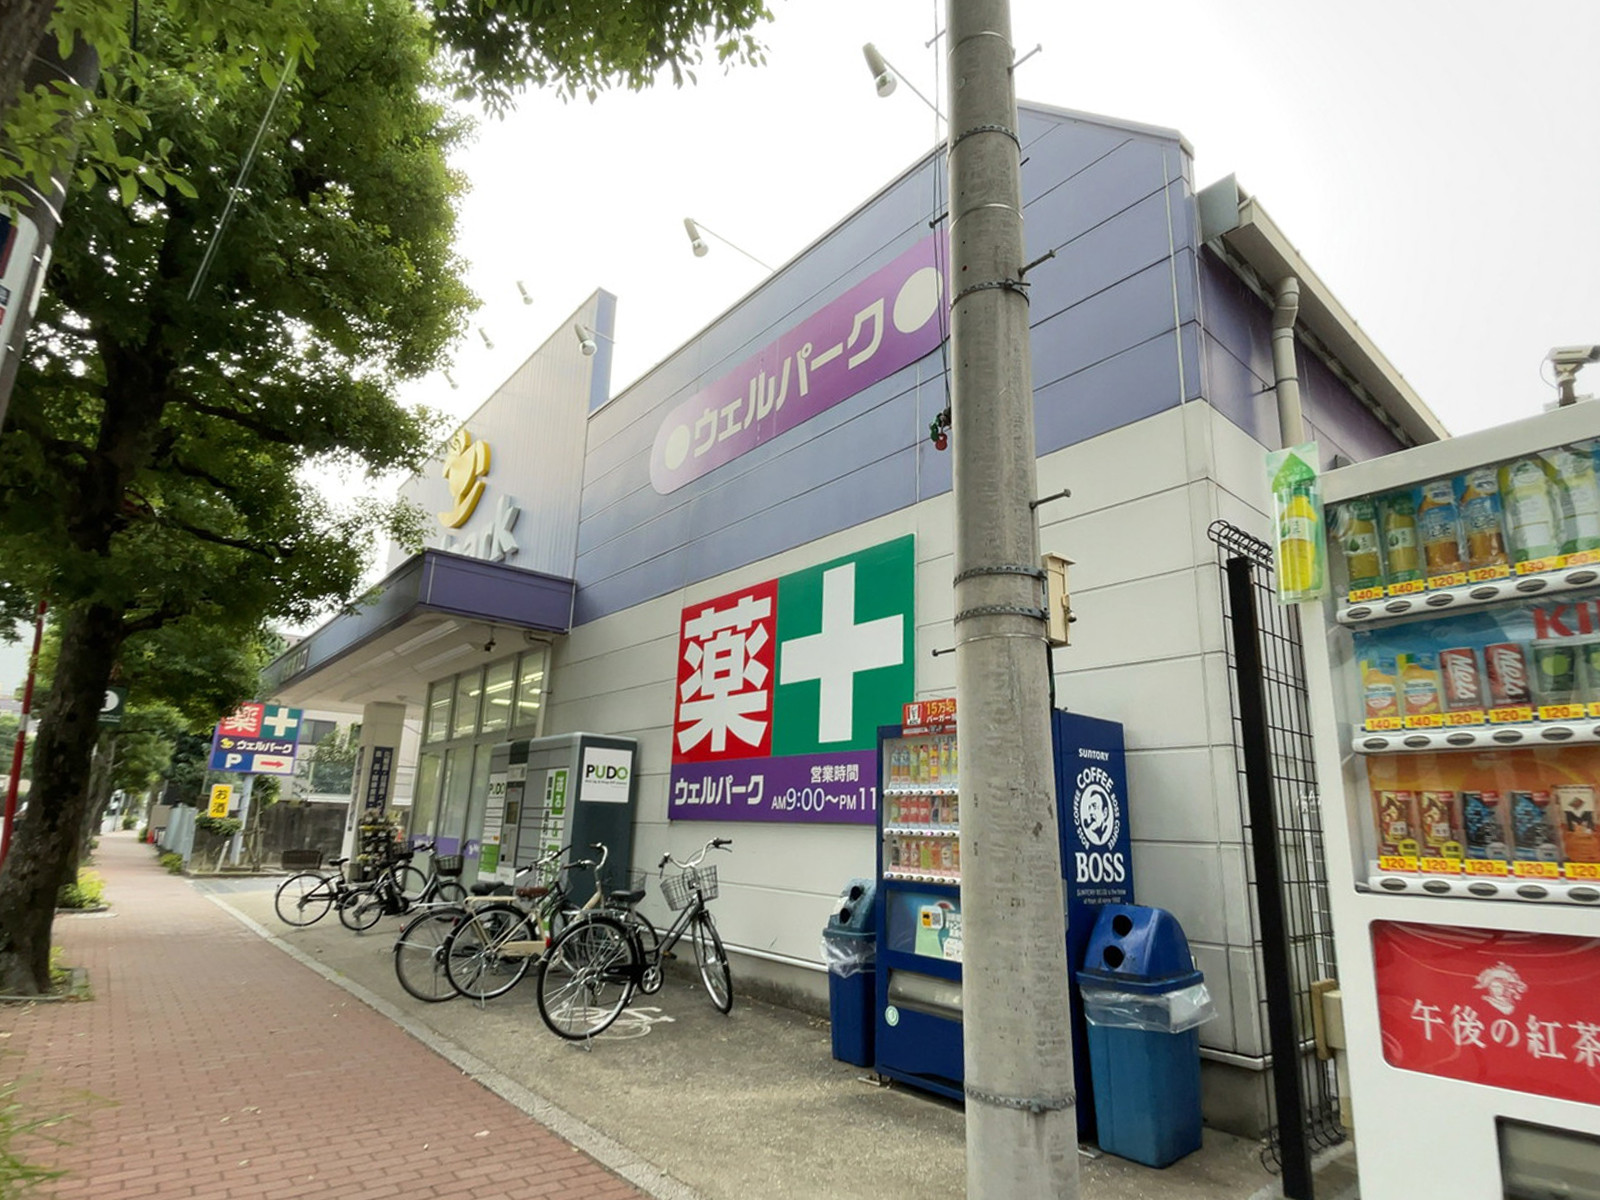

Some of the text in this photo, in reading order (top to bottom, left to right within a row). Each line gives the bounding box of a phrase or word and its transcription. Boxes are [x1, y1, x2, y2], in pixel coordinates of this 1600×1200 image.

[694, 297, 885, 458] ウェルパーク
[1533, 600, 1600, 640] KI
[677, 595, 771, 754] 薬
[1451, 654, 1477, 699] Mets
[1498, 649, 1527, 696] Mets
[225, 753, 242, 768] P
[237, 740, 293, 753] ウェルパーク
[1078, 748, 1110, 761] SUNTORY
[585, 764, 628, 780] PUDO
[811, 764, 858, 783] 営業時間
[1077, 766, 1114, 793] COFFEE
[212, 788, 227, 814] お酒
[675, 775, 764, 805] ウェルパーク
[1075, 852, 1125, 883] BOSS
[1410, 999, 1600, 1068] 午後の紅茶
